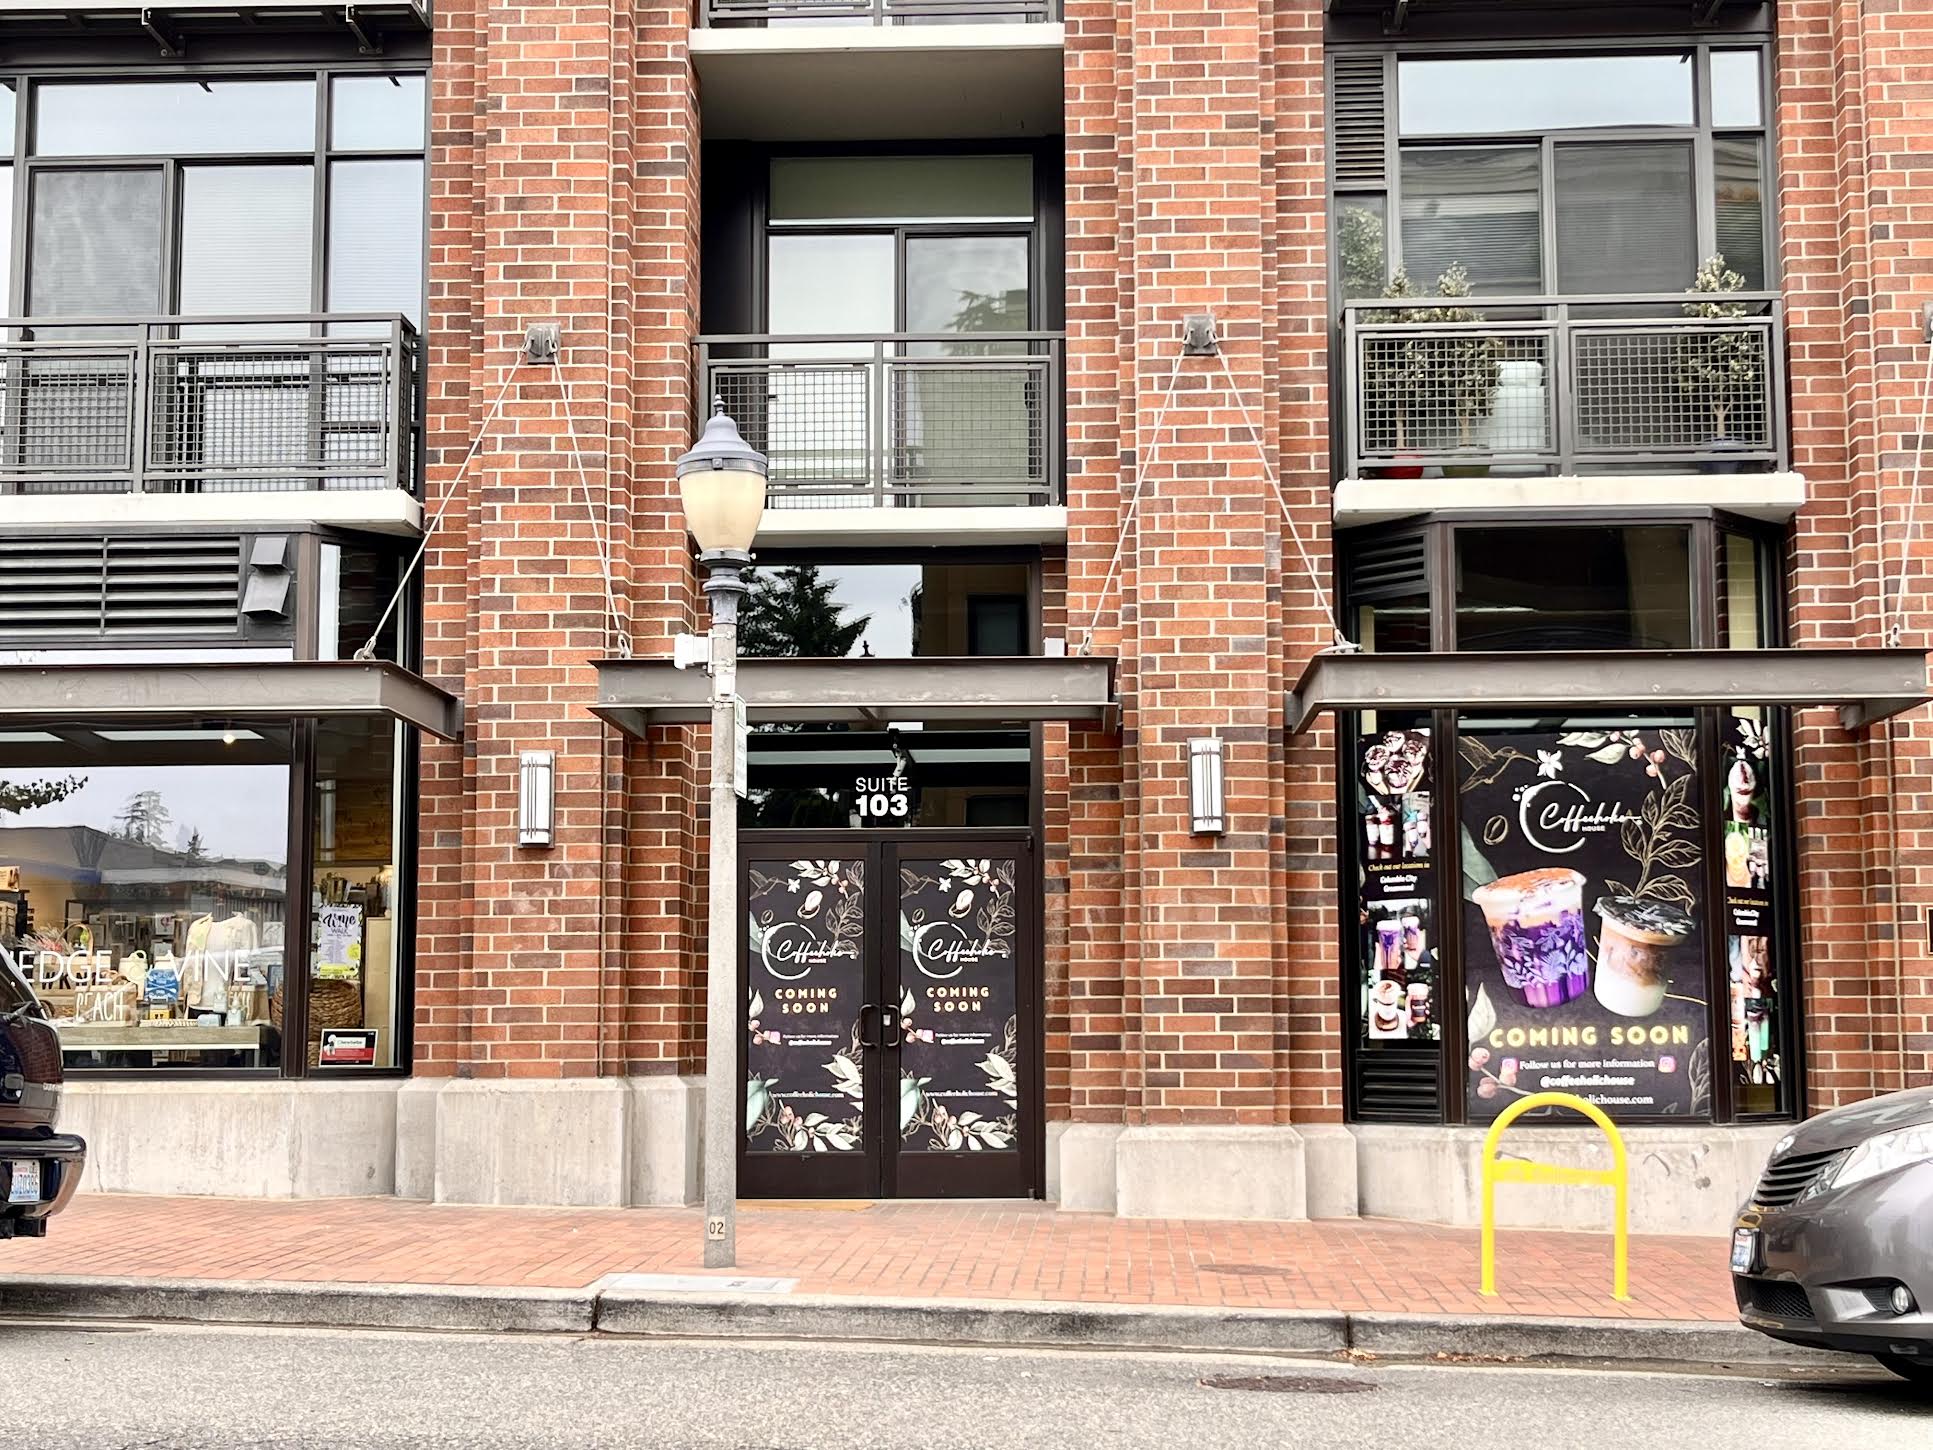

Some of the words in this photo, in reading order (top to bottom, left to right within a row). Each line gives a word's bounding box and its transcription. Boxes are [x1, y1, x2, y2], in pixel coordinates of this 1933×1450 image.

[855, 777, 908, 792] SUITE
[855, 793, 908, 817] 103
[10, 949, 113, 983] EDGE
[167, 949, 251, 982] VINE
[775, 987, 838, 1000] COMING
[926, 986, 990, 998] COMING
[782, 1002, 829, 1014] SOON
[933, 1001, 981, 1012] SOON
[1489, 1026, 1598, 1048] COMING
[1610, 1025, 1689, 1045] SOON
[1519, 1060, 1549, 1071] Follow
[1550, 1060, 1562, 1069] us
[1563, 1059, 1577, 1069] for
[1578, 1060, 1602, 1069] more
[1602, 1058, 1656, 1068] information
[1540, 1074, 1636, 1088] @coffeeholichouse
[709, 1221, 724, 1235] 02
